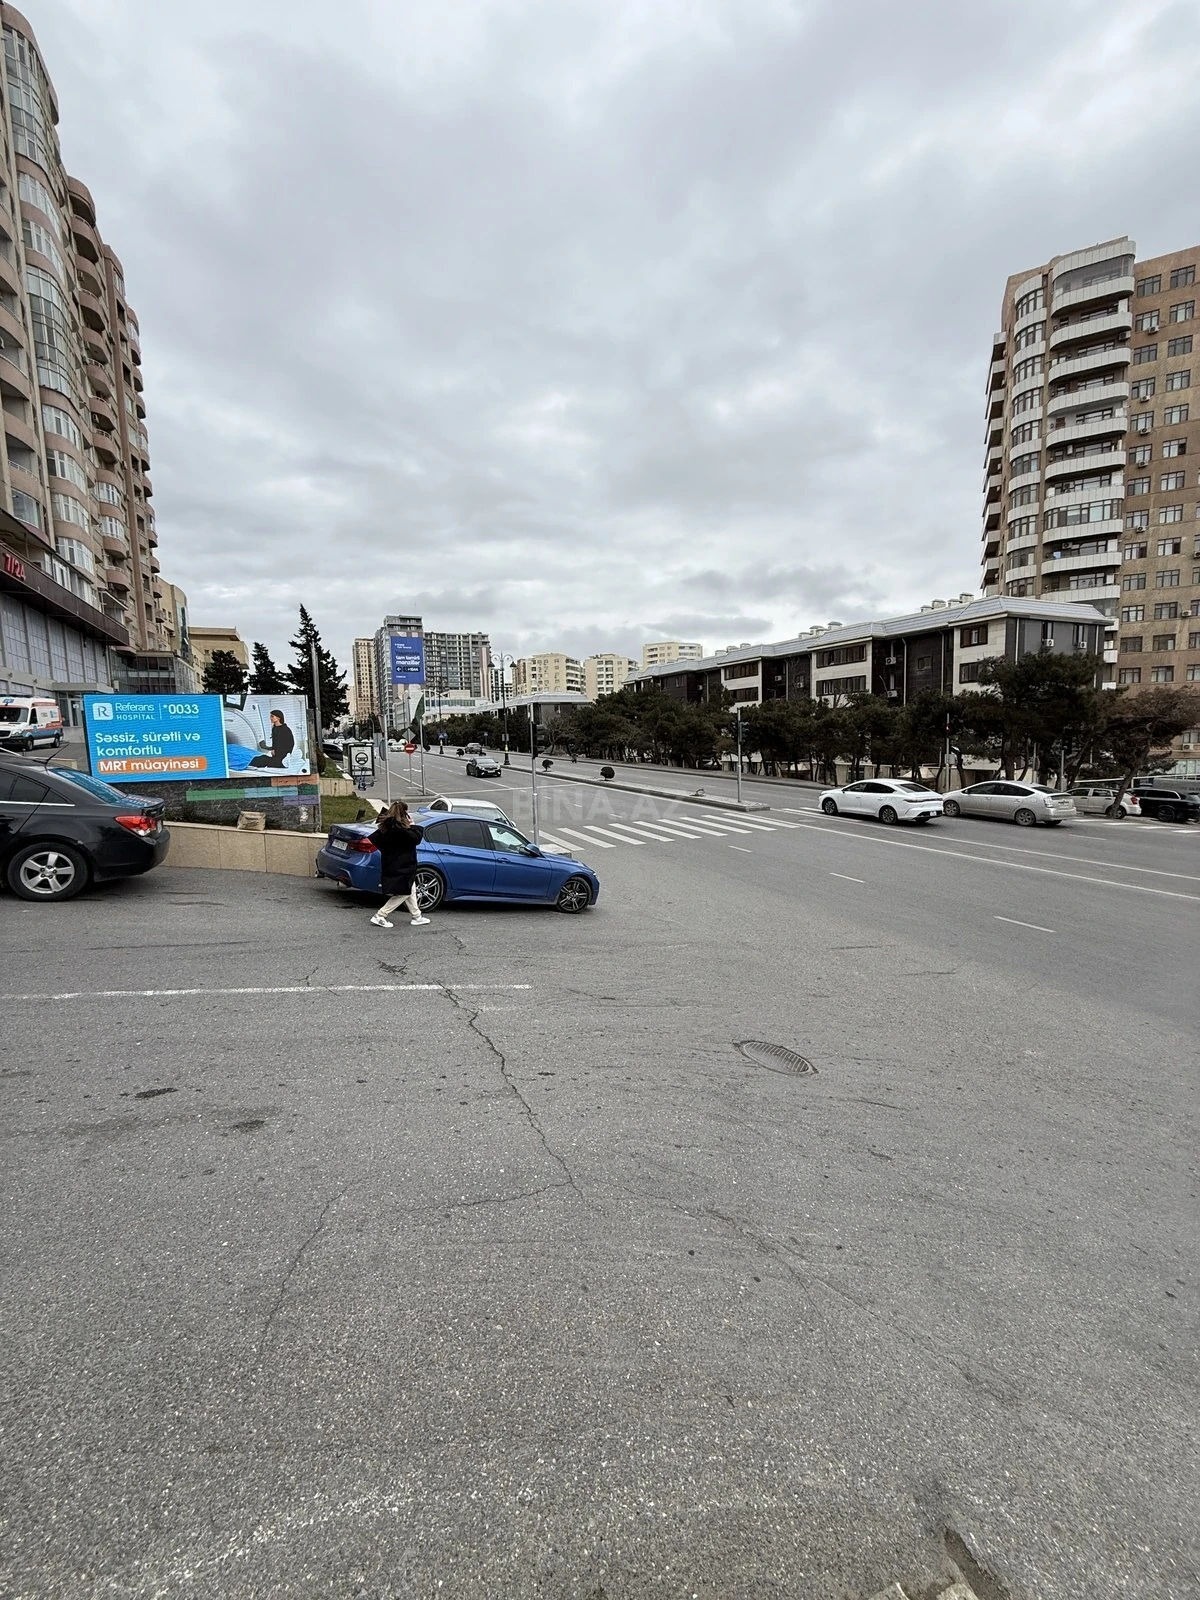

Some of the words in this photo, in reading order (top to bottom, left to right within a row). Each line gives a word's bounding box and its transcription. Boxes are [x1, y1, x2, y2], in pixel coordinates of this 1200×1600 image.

[115, 702, 155, 712] Referans
[95, 732, 139, 743] Səssiz,
[142, 731, 181, 742] sürətli
[184, 732, 200, 741] və
[96, 745, 162, 756] komfortlu
[99, 760, 128, 771] MRT
[131, 758, 199, 772] müayinəsi
